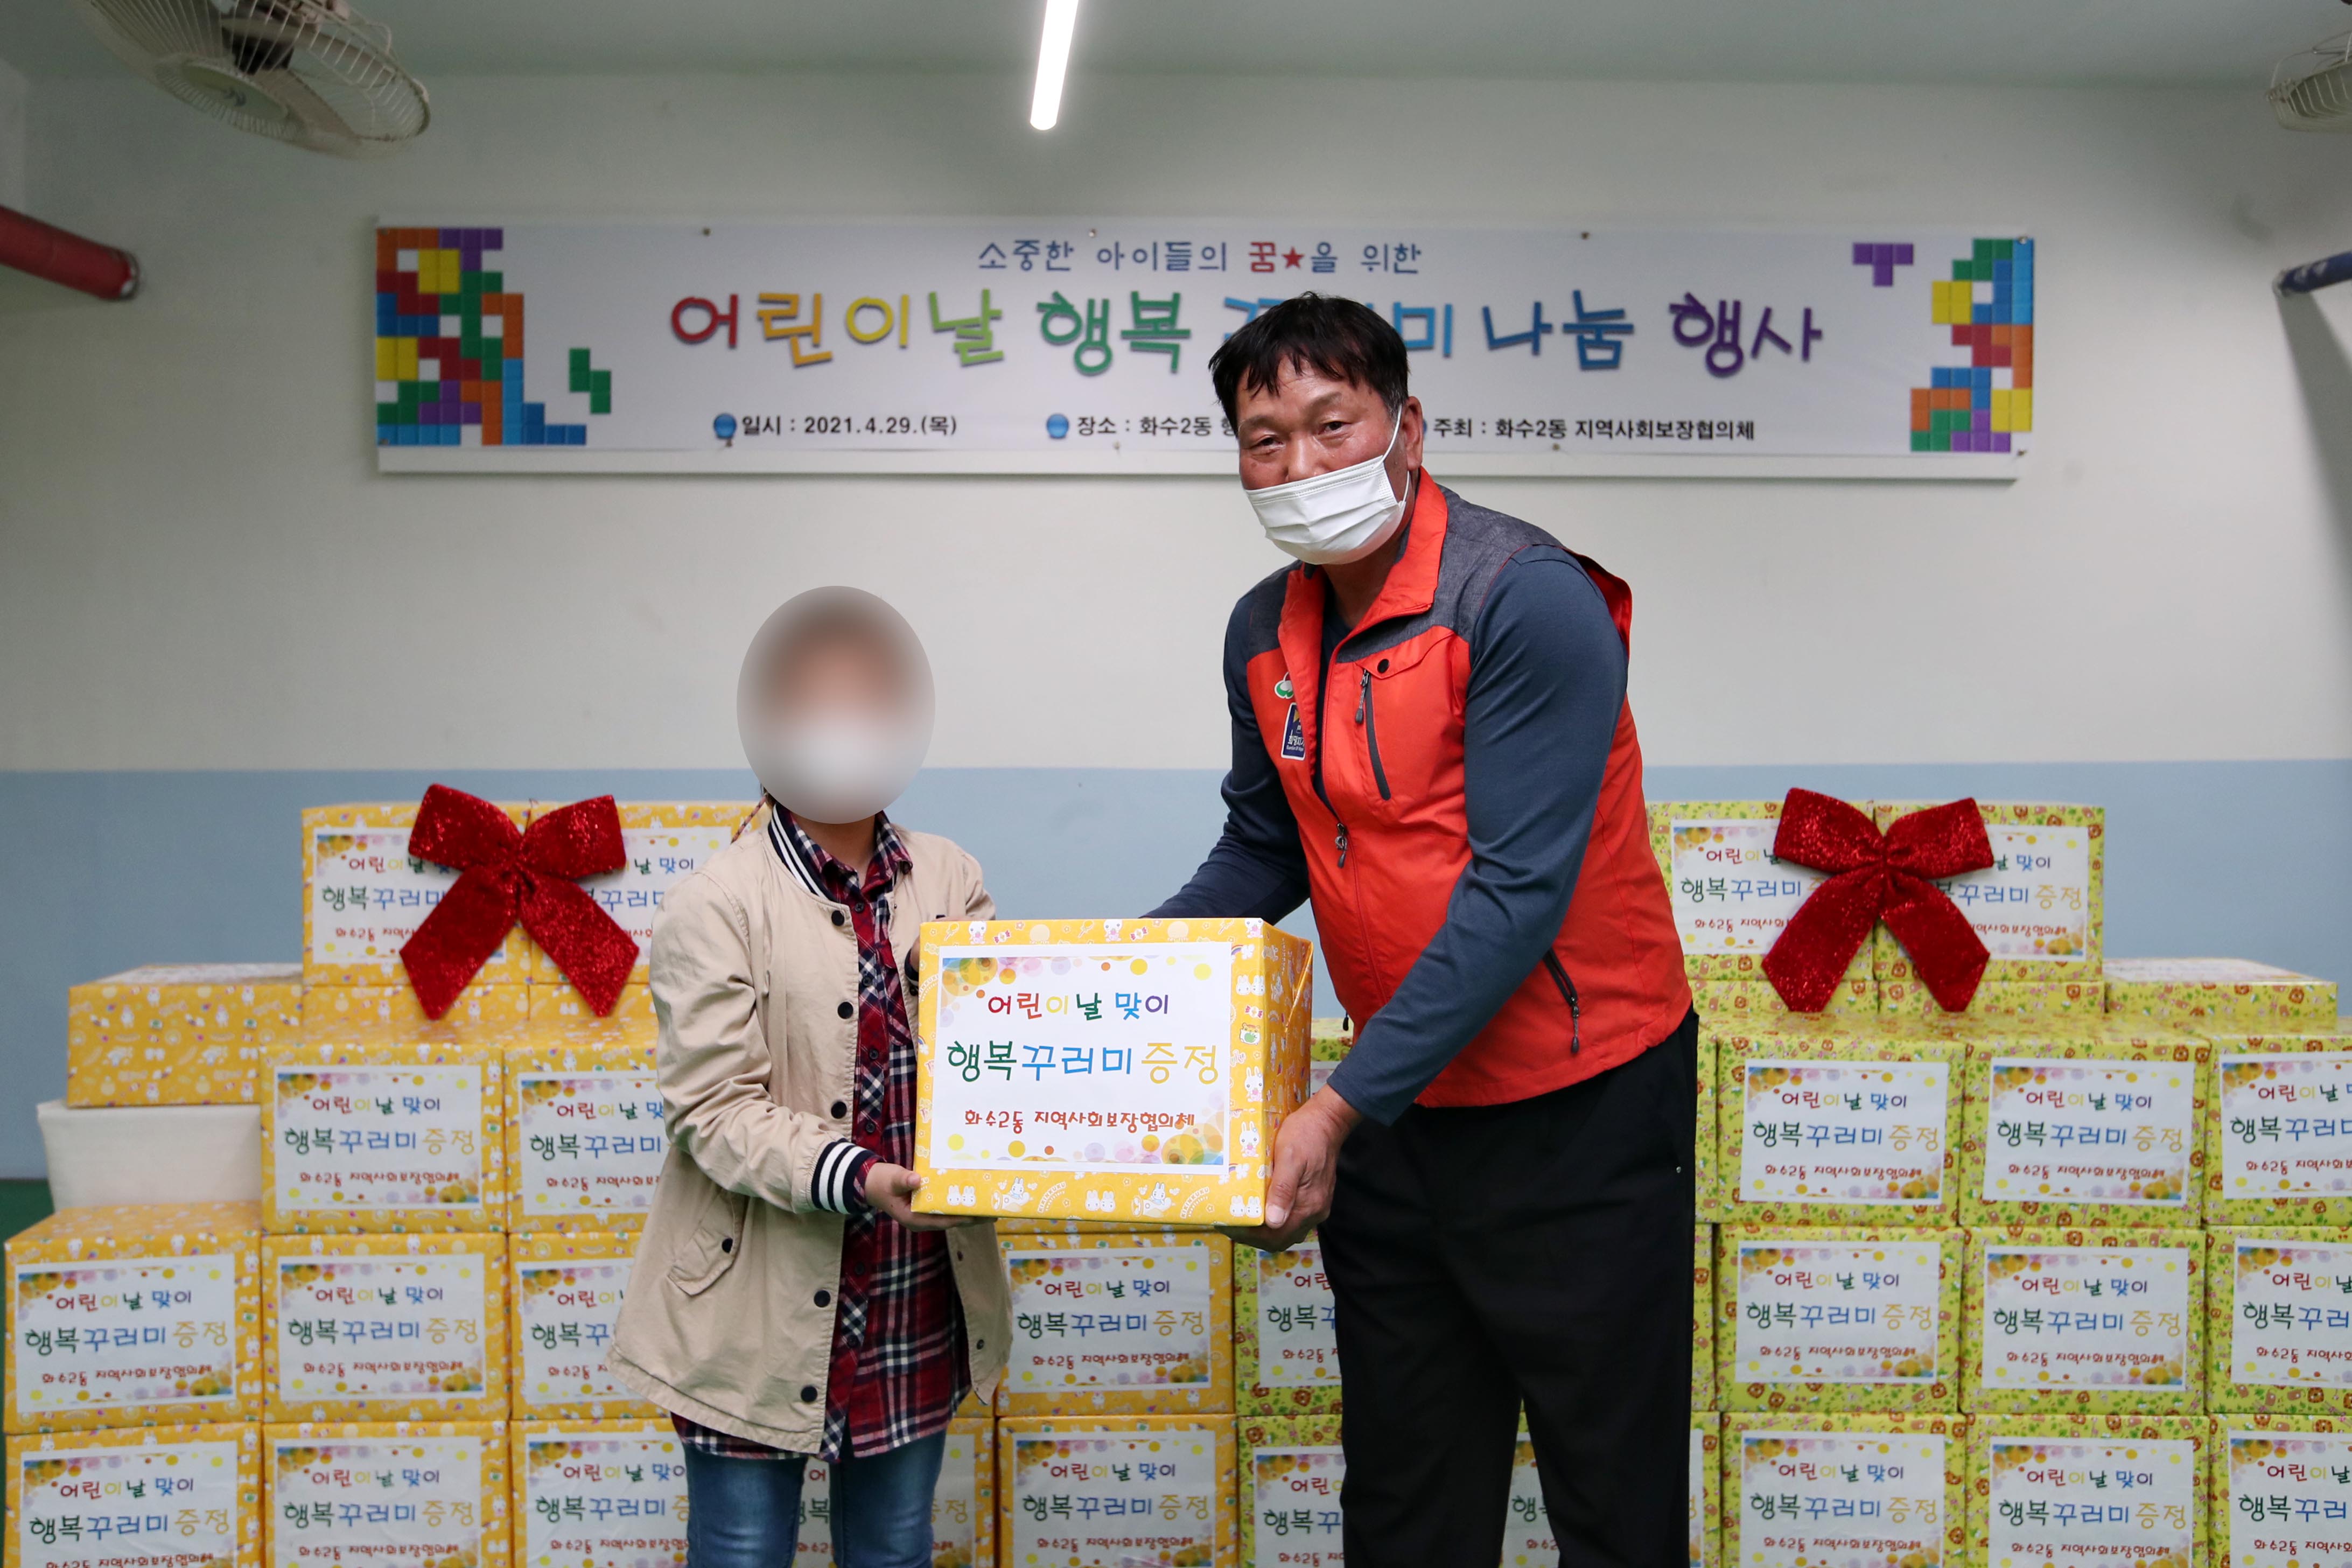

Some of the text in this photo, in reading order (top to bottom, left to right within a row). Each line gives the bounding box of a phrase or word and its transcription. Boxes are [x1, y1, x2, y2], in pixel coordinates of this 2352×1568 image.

[978, 239, 1074, 271] 소중한
[1096, 241, 1227, 271] 아이들의
[1361, 242, 1422, 274] 위한
[670, 288, 1004, 368] 어린이날
[1036, 290, 1191, 376] 행복
[1481, 289, 1635, 371] 나눔
[1668, 291, 1823, 378] 행사
[741, 415, 781, 436] 일시
[1077, 416, 1117, 437] 장소
[1140, 416, 1212, 437] 화수2동
[1433, 418, 1472, 438] 주최
[1495, 418, 1567, 439] 화수2동
[1575, 419, 1754, 440] 지역사회보장협의체
[659, 857, 694, 874] 맞이
[2016, 855, 2050, 871] 맞이
[988, 992, 1168, 1021] 어린이날 맞이
[1782, 1091, 1907, 1111] 어린이날 맞이
[2026, 1090, 2152, 1111] 어린이날 맞이
[2258, 1084, 2339, 1103] 어린이날
[312, 1096, 440, 1115] 어린이날 맞이
[557, 1102, 663, 1121] 어린이날 맞
[2294, 1159, 2352, 1174] 지역사회보
[1045, 1279, 1170, 1299] 어린이날 맞이
[1294, 1272, 1331, 1292] 어린
[1775, 1271, 1899, 1291] 어린이날 맞이
[2022, 1277, 2147, 1297] 어린이날 맞이
[55, 1290, 191, 1312] 어린이날 맞이
[315, 1286, 443, 1306] 어린이날 맞이
[557, 1289, 624, 1308] 어린이
[312, 1469, 439, 1488] 어린이날 맞이
[563, 1464, 643, 1483] 어린이날
[1050, 1463, 1175, 1482] 어린이날 맞이
[1779, 1462, 1903, 1483] 어린이날 맞이
[2027, 1469, 2153, 1489] 어린이날 맞이
[2267, 1464, 2351, 1484] 어린이날
[60, 1478, 193, 1500] 어린이날 맞이
[1290, 1476, 1342, 1496] 어린
[669, 1494, 689, 1522] 증
